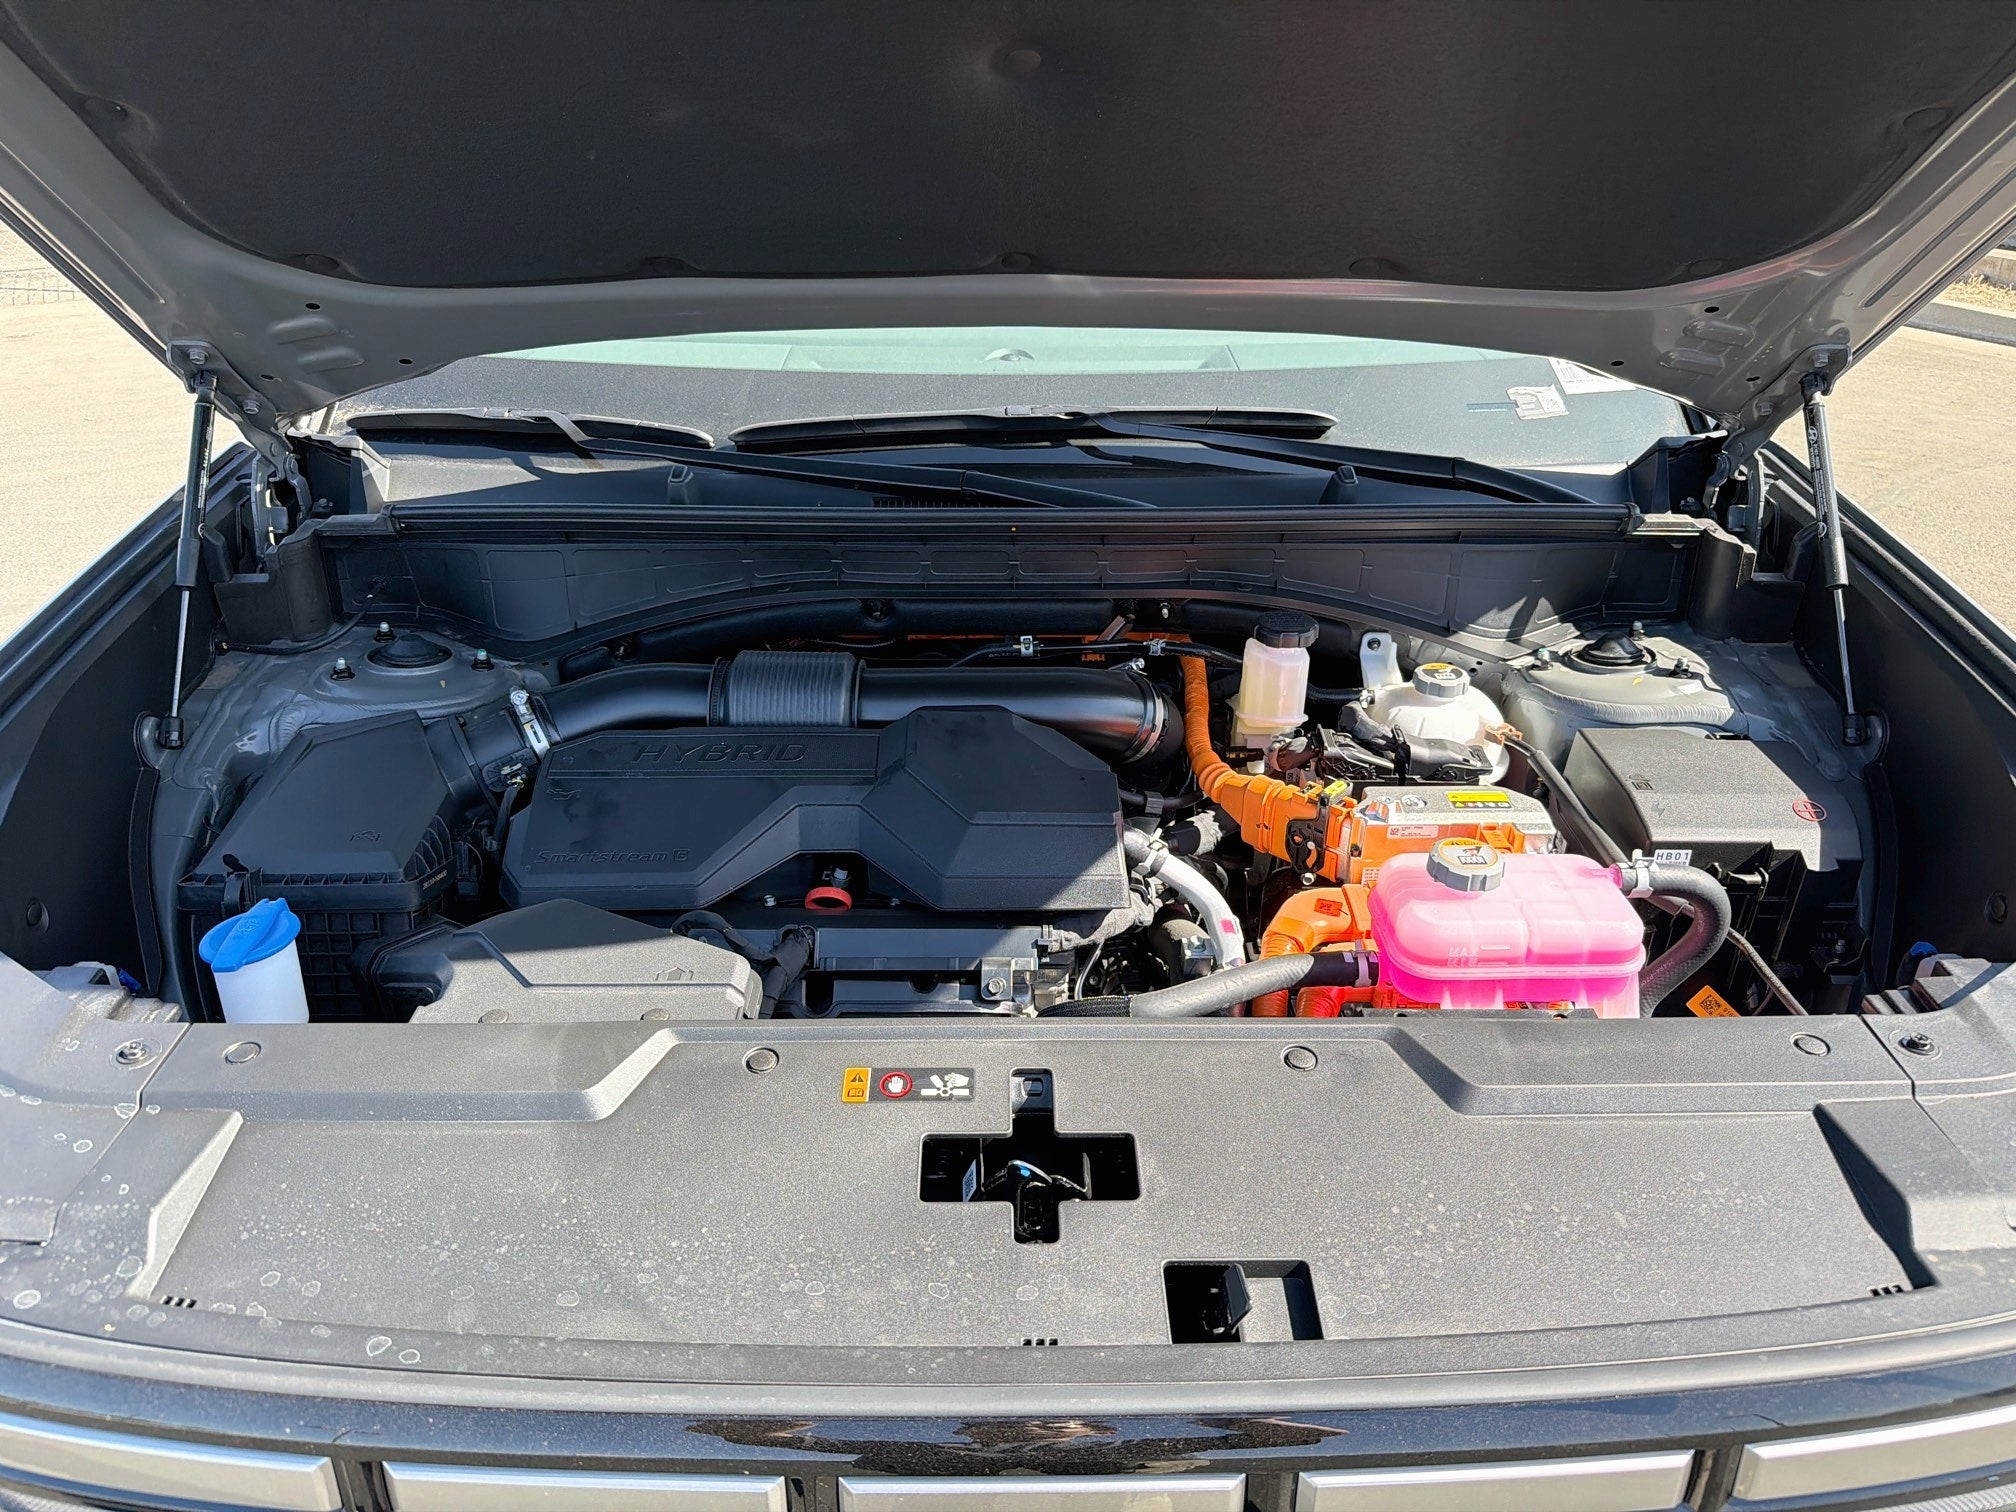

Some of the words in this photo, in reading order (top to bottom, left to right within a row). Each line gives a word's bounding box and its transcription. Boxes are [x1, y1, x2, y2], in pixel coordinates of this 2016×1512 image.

[631, 743, 808, 764] HYBRID
[534, 849, 667, 864] Smartstream
[1656, 852, 1690, 861] HB01
